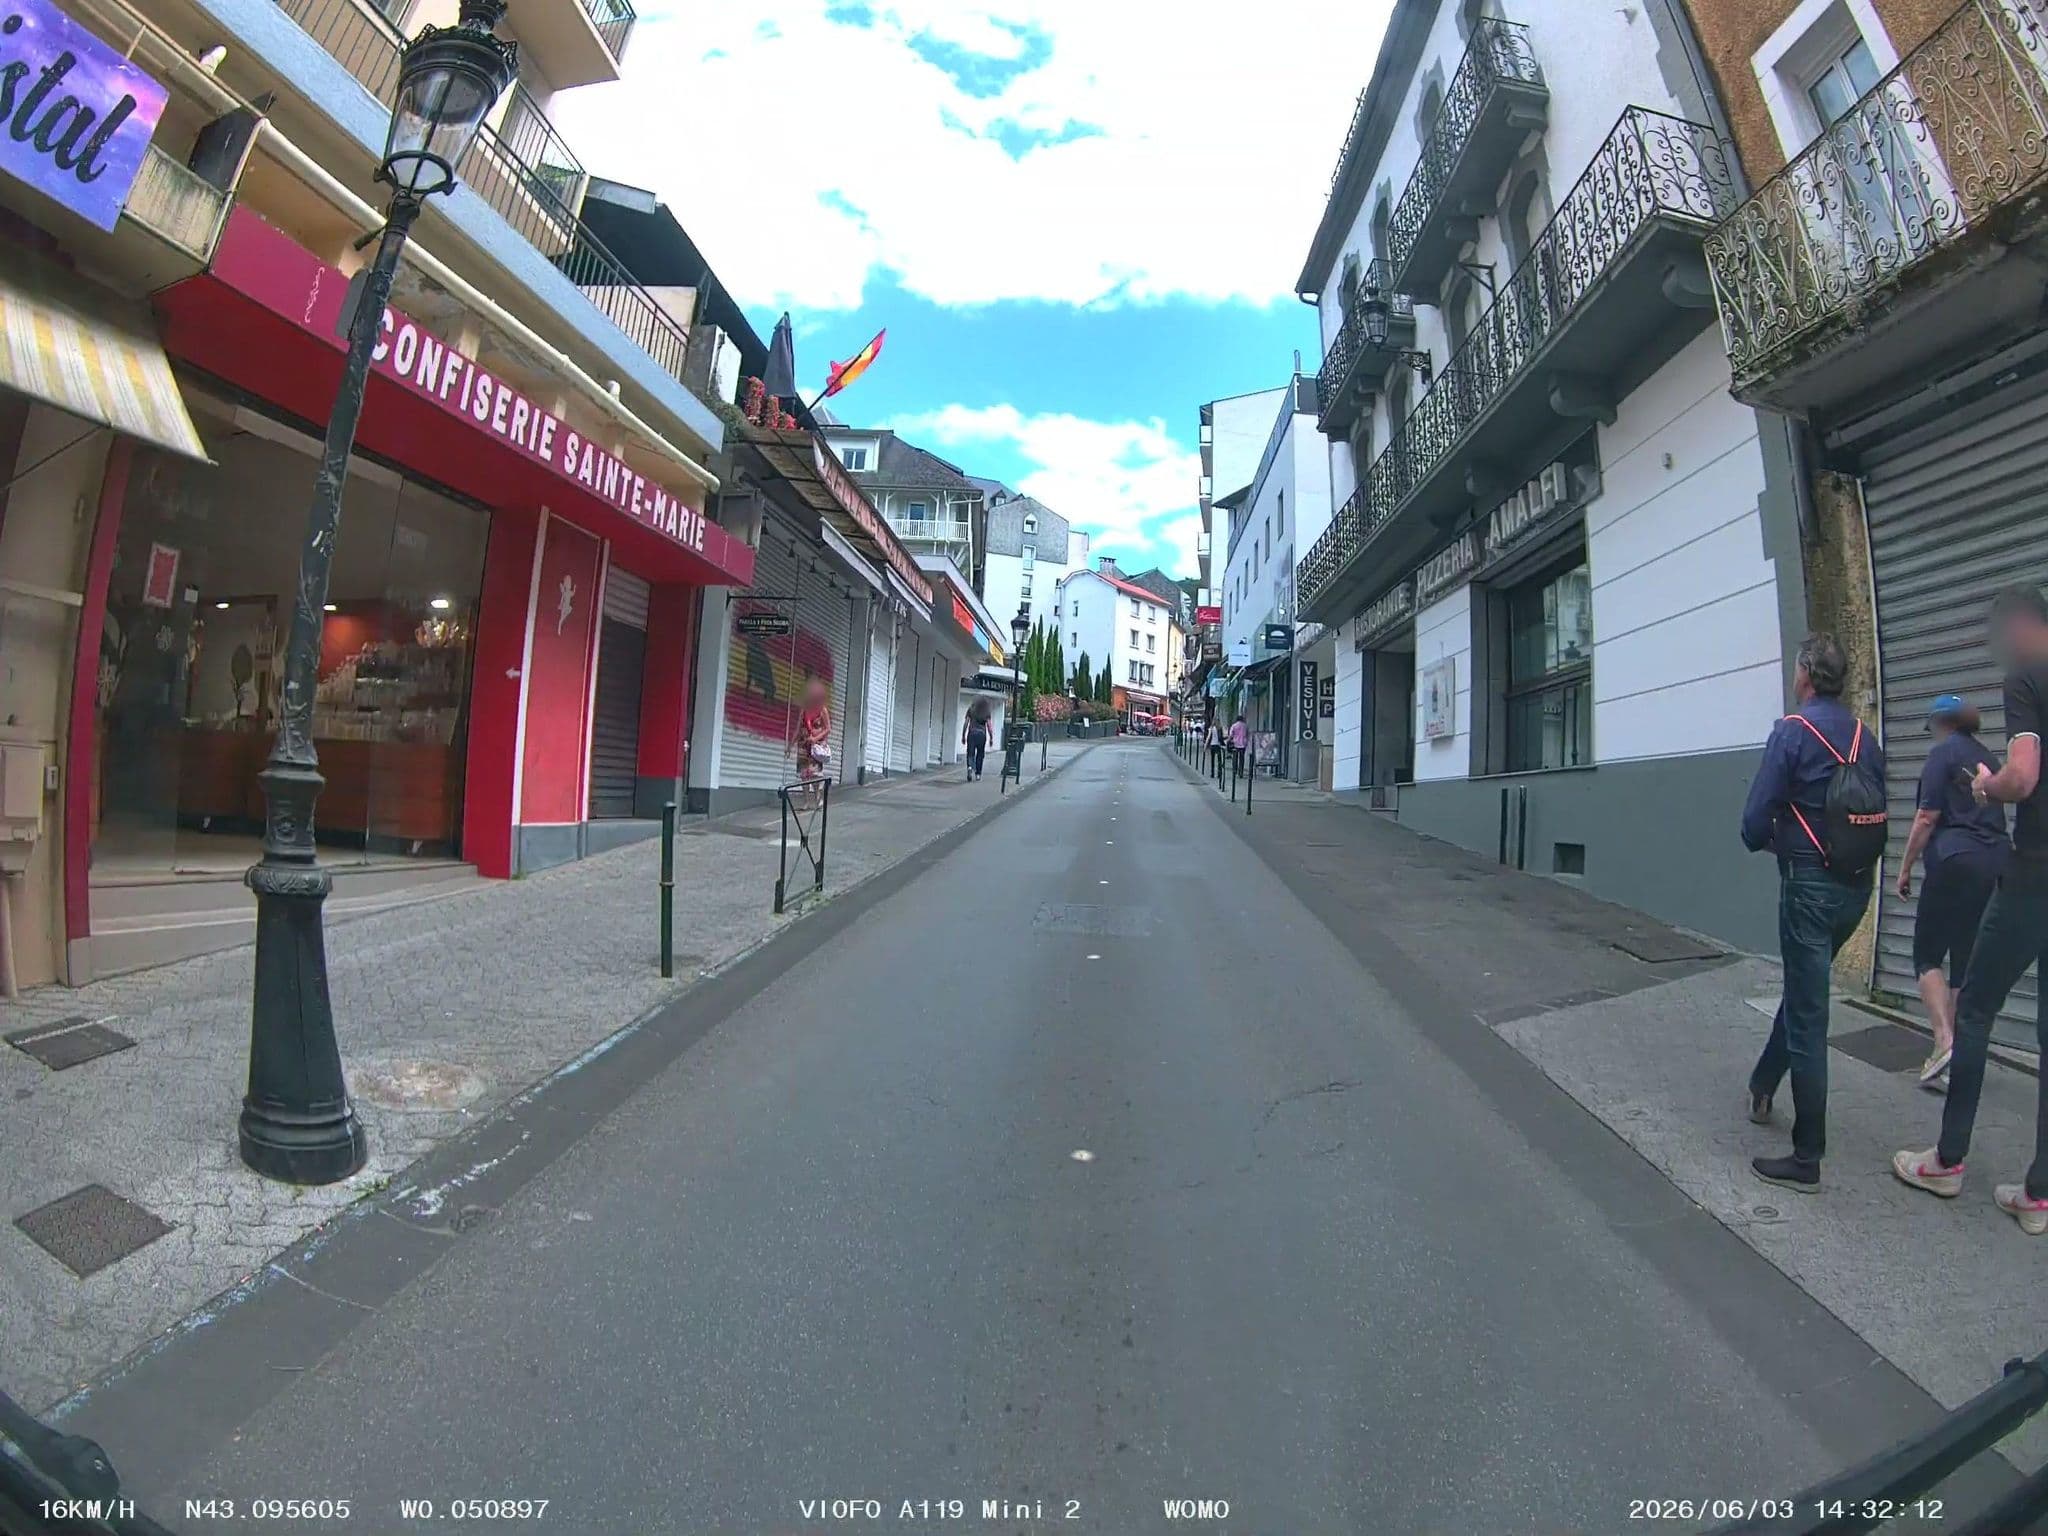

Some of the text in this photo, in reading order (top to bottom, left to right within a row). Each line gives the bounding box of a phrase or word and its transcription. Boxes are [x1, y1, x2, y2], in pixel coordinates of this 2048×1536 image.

[0, 14, 137, 184] stal
[372, 308, 557, 460] CONFISERIE
[564, 432, 706, 552] SAINTE-MARIE
[1415, 532, 1475, 614] PIZZERIA
[1486, 461, 1567, 550] AMALFI
[1302, 664, 1315, 740] VESUVIO
